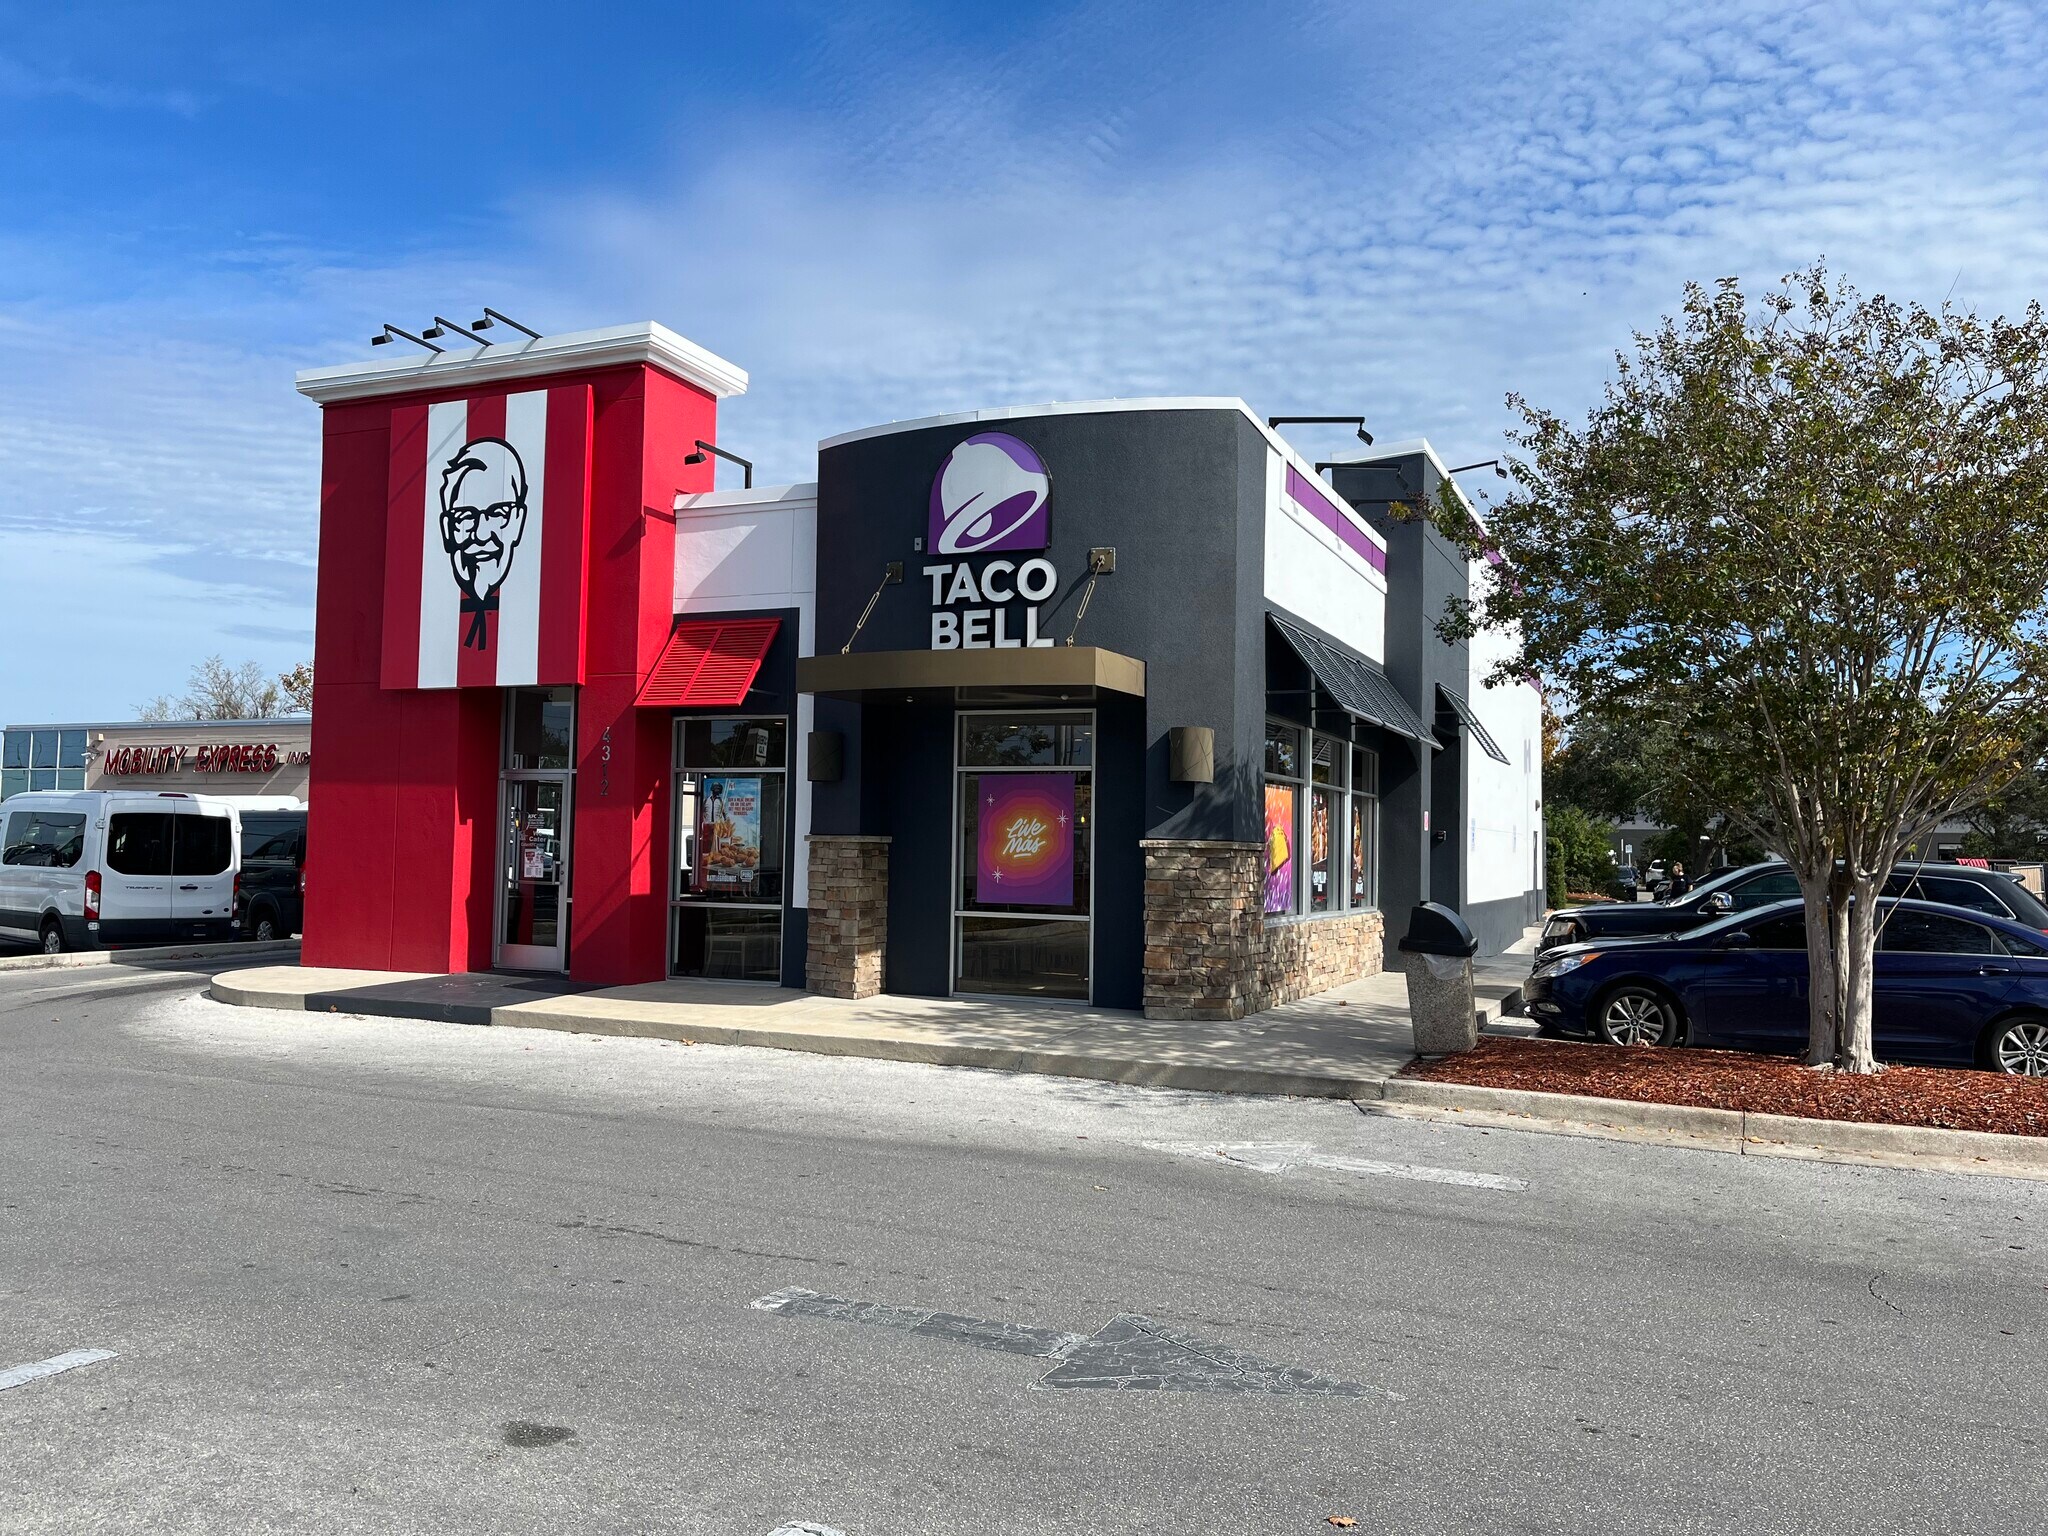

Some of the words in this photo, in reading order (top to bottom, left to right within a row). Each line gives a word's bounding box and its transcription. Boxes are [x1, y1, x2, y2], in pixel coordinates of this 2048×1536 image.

[923, 558, 1058, 606] TACO
[931, 606, 1055, 651] BELL
[103, 745, 189, 775] MOBILITY
[193, 744, 280, 773] EXPRESS
[600, 725, 611, 796] 4312
[1007, 818, 1047, 839] Live
